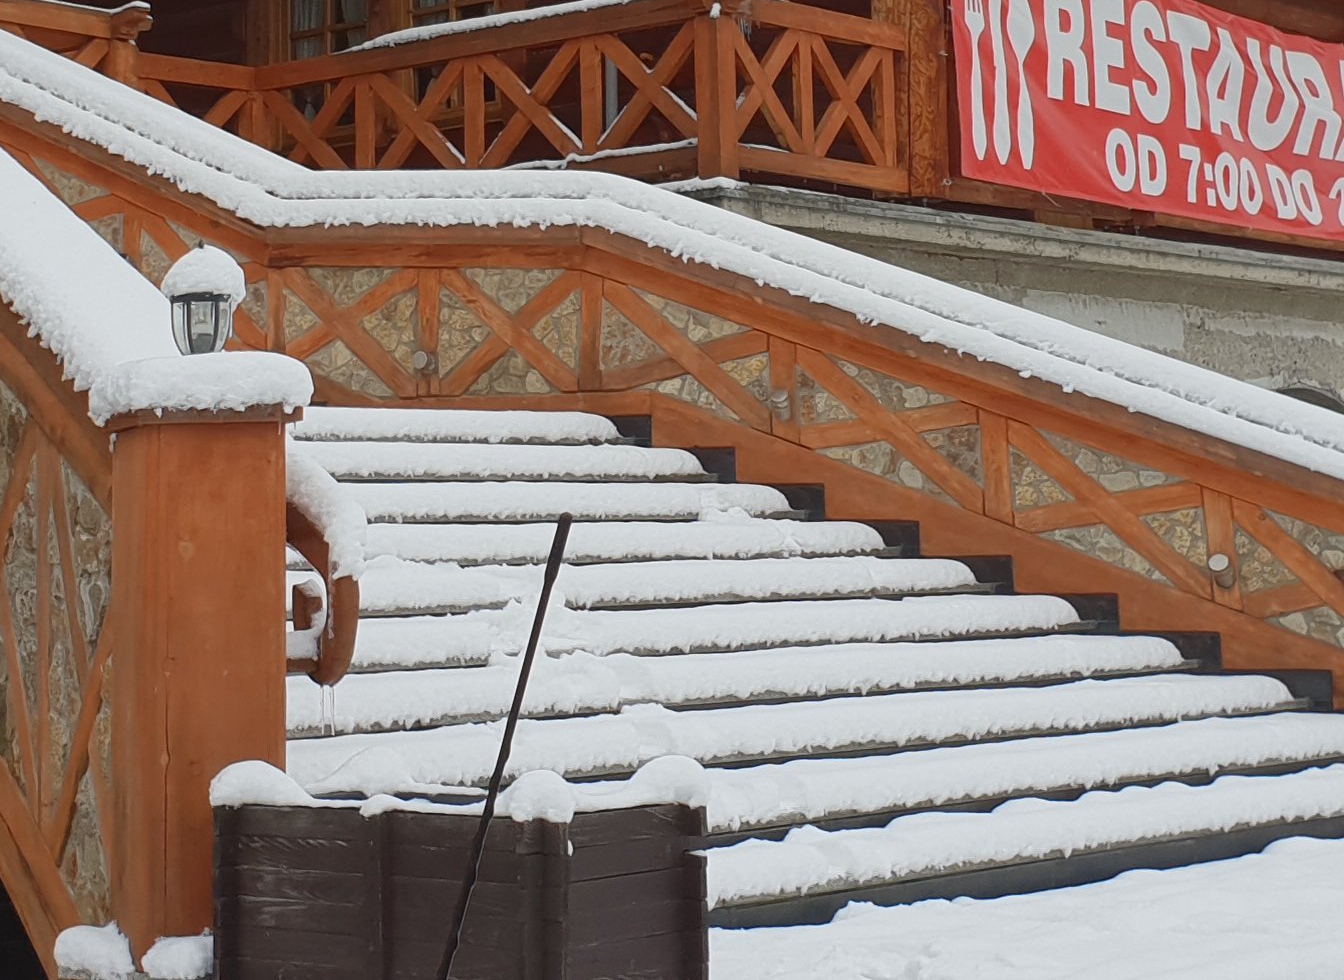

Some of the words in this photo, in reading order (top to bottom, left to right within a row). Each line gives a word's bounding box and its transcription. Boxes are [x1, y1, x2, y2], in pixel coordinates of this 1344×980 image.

[1105, 128, 1167, 196] OD
[1178, 144, 1263, 215] 7:00
[1266, 163, 1322, 226] DO
